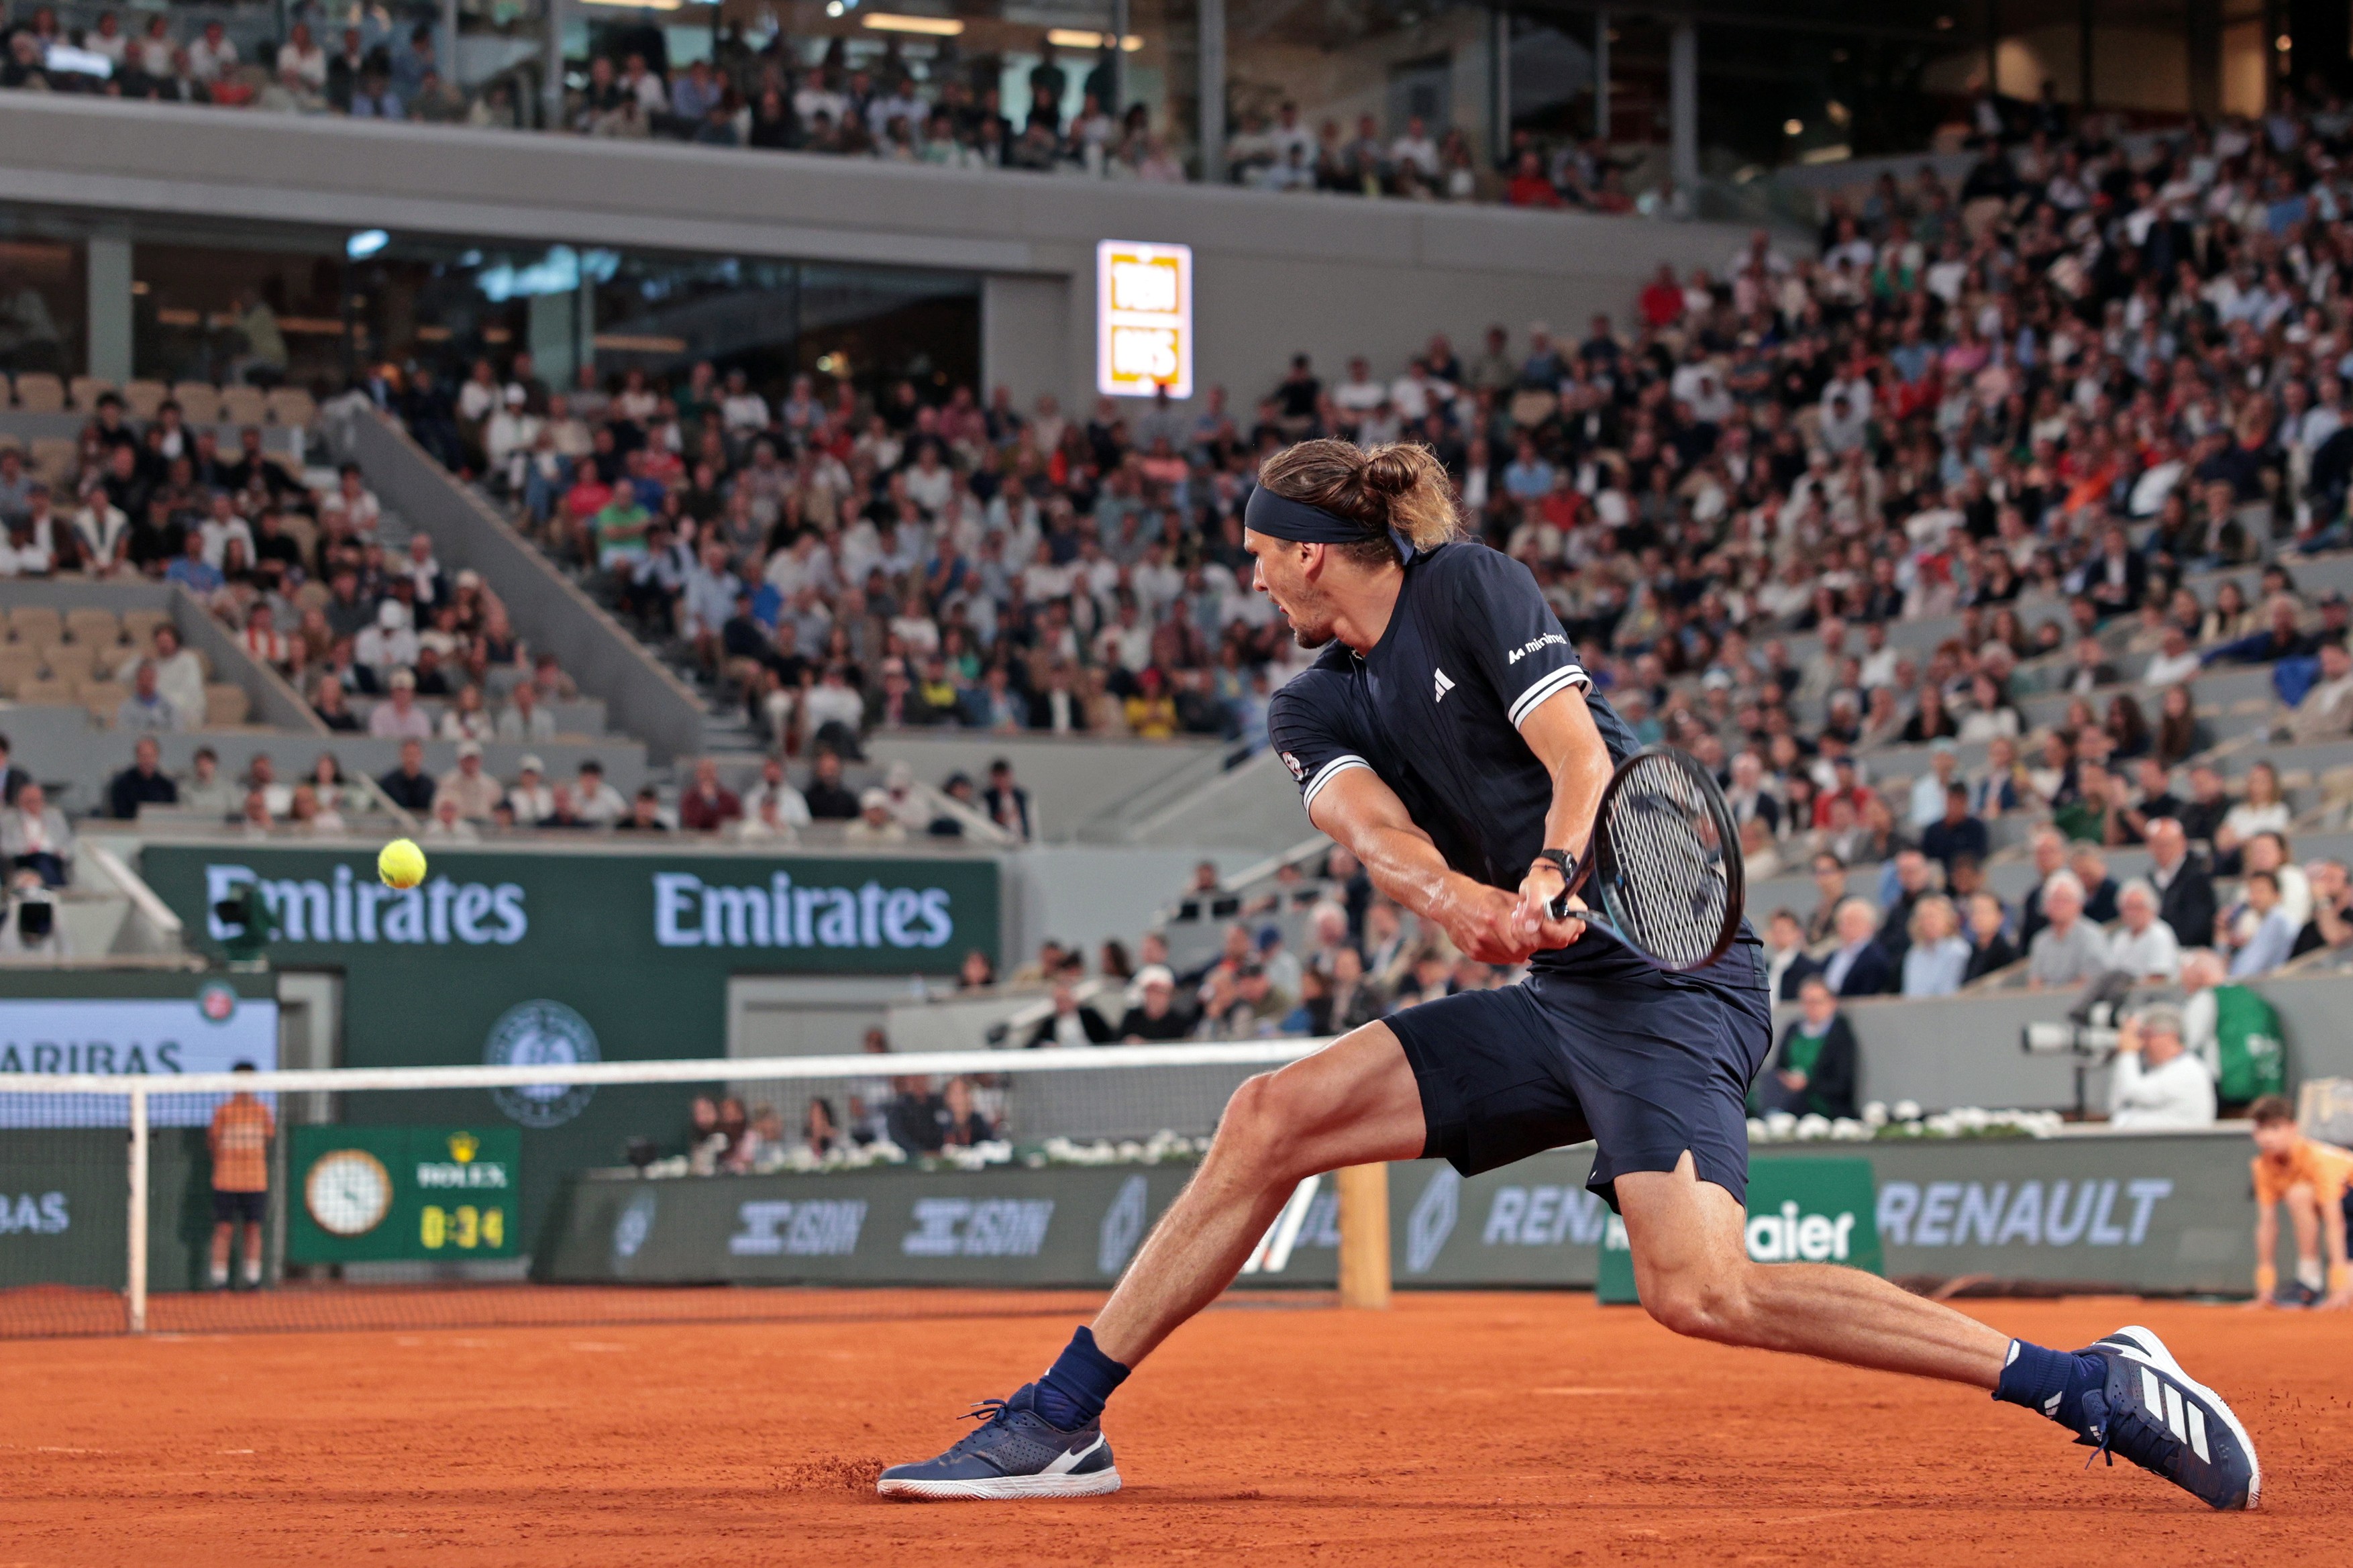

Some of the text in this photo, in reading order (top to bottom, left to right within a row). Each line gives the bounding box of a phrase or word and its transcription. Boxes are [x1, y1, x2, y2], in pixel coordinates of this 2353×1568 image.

[206, 864, 527, 943] Emirates
[652, 870, 953, 947] Emirates
[1745, 1200, 1854, 1260] aier
[1876, 1178, 2174, 1246] RENAULT
